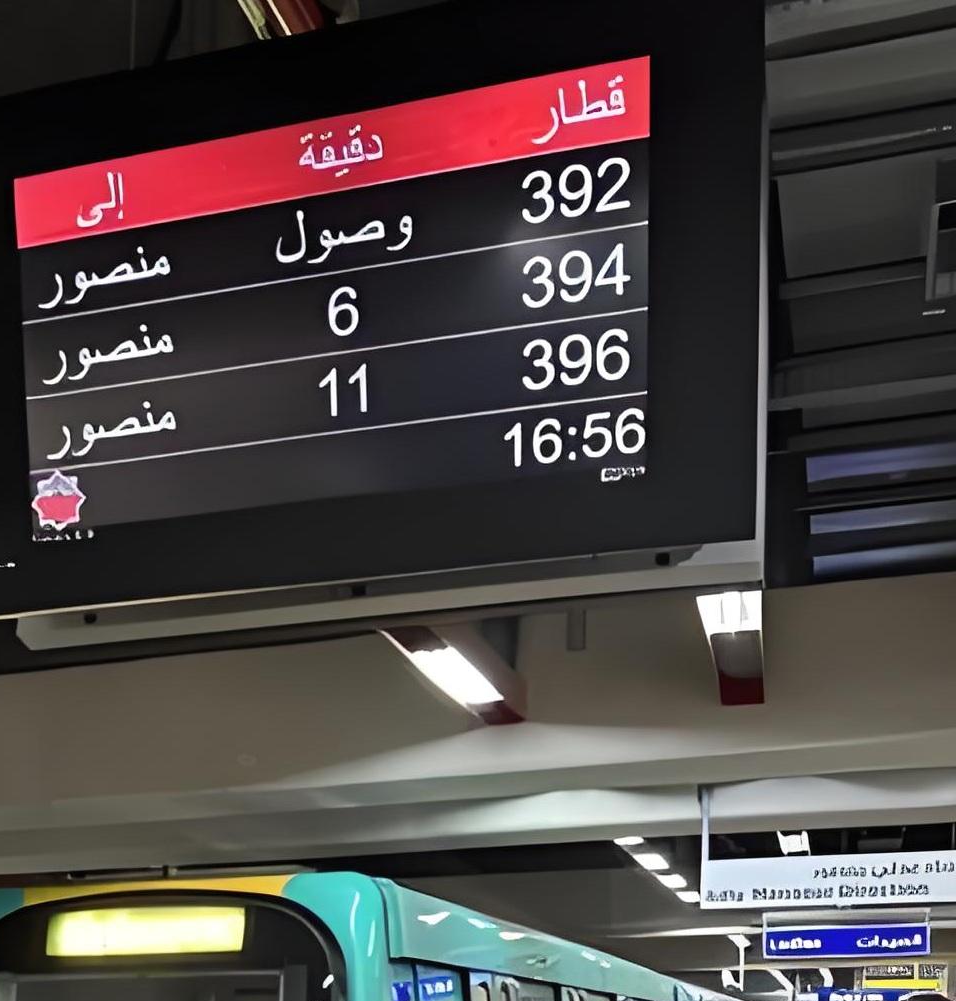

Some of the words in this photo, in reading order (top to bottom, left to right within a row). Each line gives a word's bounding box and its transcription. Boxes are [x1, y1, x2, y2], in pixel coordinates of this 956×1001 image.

[532, 75, 626, 145] قطار
[298, 124, 384, 177] دقيقة
[76, 171, 125, 228] إلى
[521, 157, 632, 224] 392
[275, 210, 414, 264] وصول
[38, 246, 172, 309] منصور
[522, 242, 632, 309] 394
[328, 286, 359, 337] 6
[42, 324, 174, 385] منصور
[522, 328, 631, 391] 396
[318, 363, 369, 417] 11
[46, 401, 177, 460] منصور
[503, 407, 646, 467] 16:56
